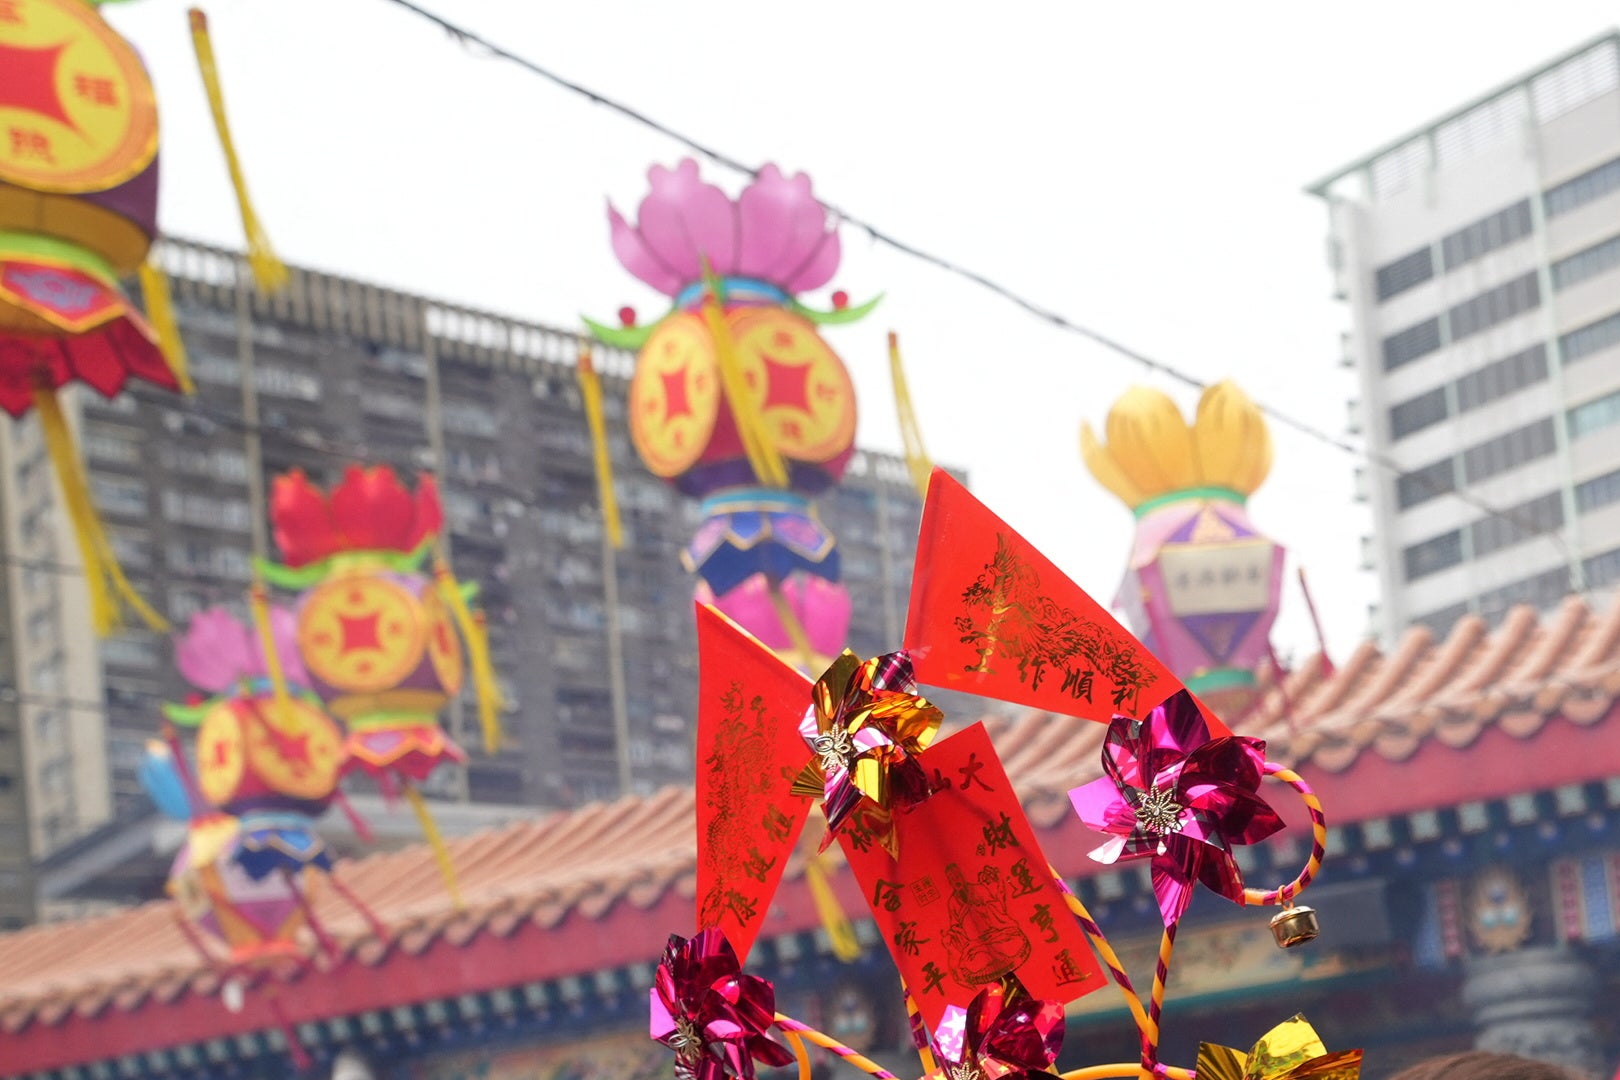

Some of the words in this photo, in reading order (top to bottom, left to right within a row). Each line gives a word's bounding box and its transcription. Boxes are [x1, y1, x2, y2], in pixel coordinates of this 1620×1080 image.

[964, 647, 1144, 716] 工作順利
[982, 812, 1092, 987] 財運亨通
